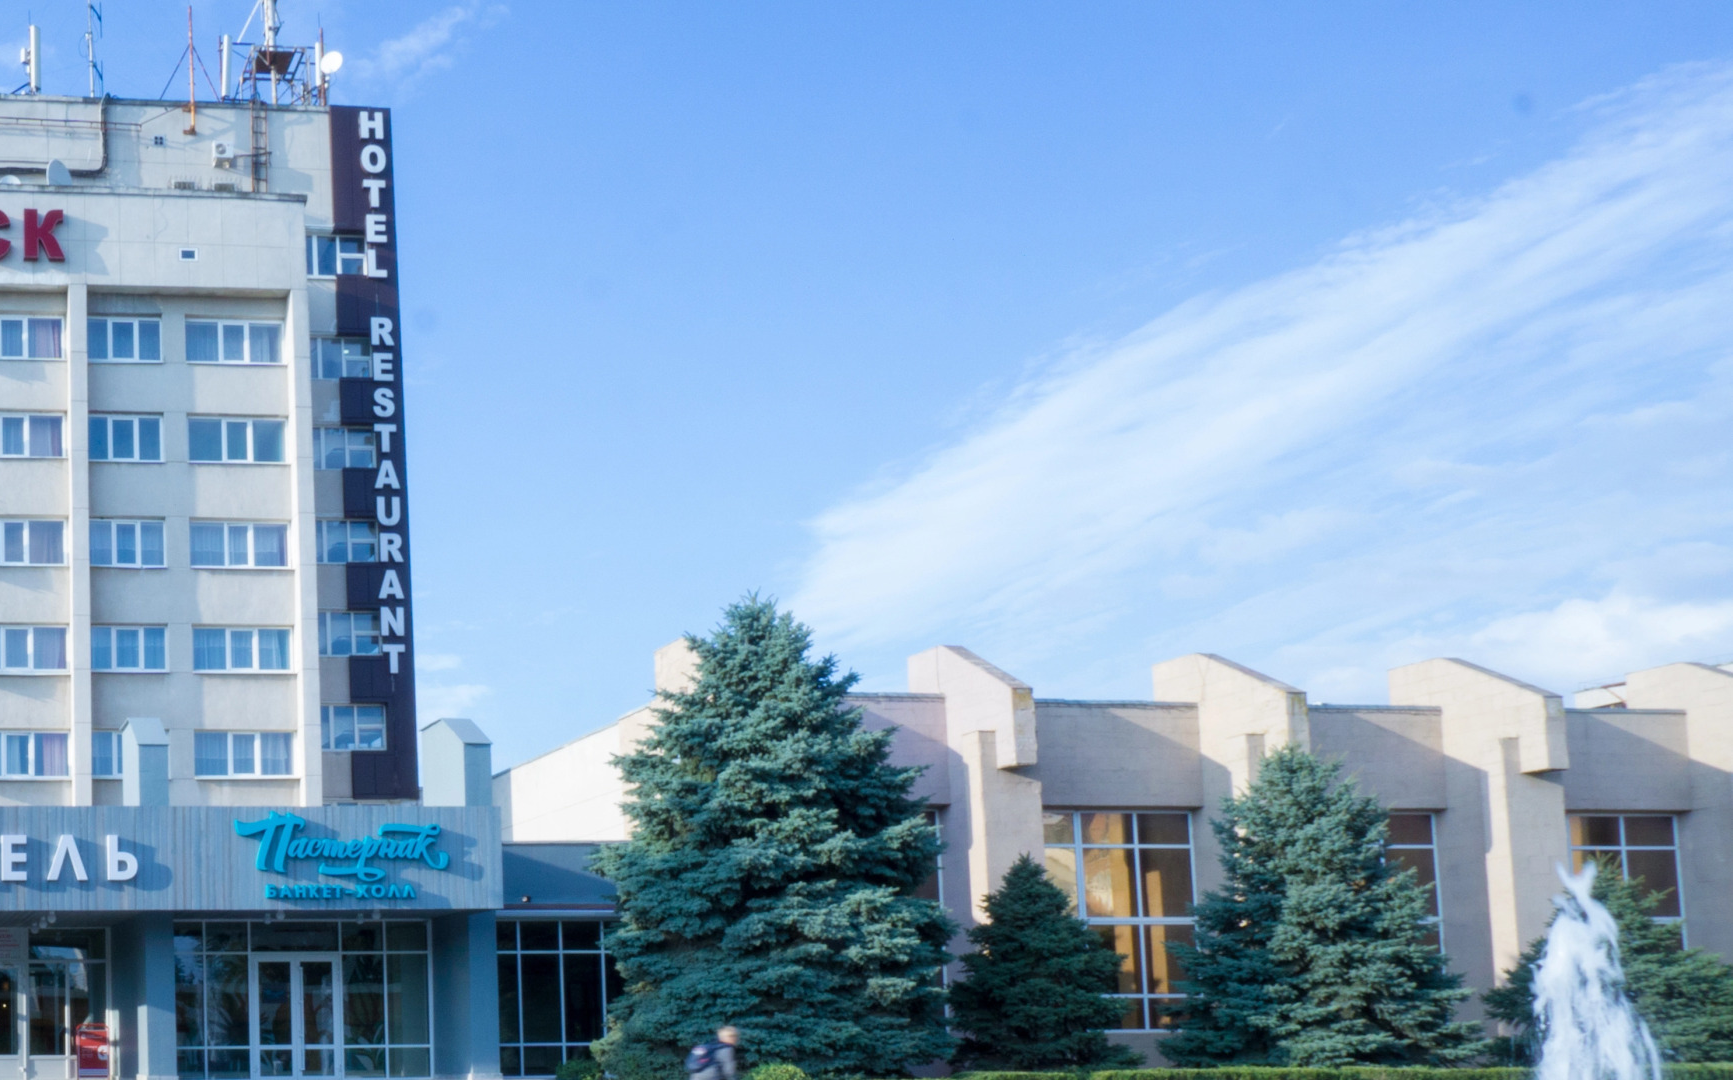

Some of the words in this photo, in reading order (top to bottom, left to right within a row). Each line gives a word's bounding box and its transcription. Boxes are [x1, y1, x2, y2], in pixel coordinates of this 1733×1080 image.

[358, 112, 388, 278] HOTEL
[370, 317, 405, 673] RESTAURANT
[234, 811, 450, 881] Пастернак
[265, 884, 416, 899] БАНКЕТ-ХОЛЛ
